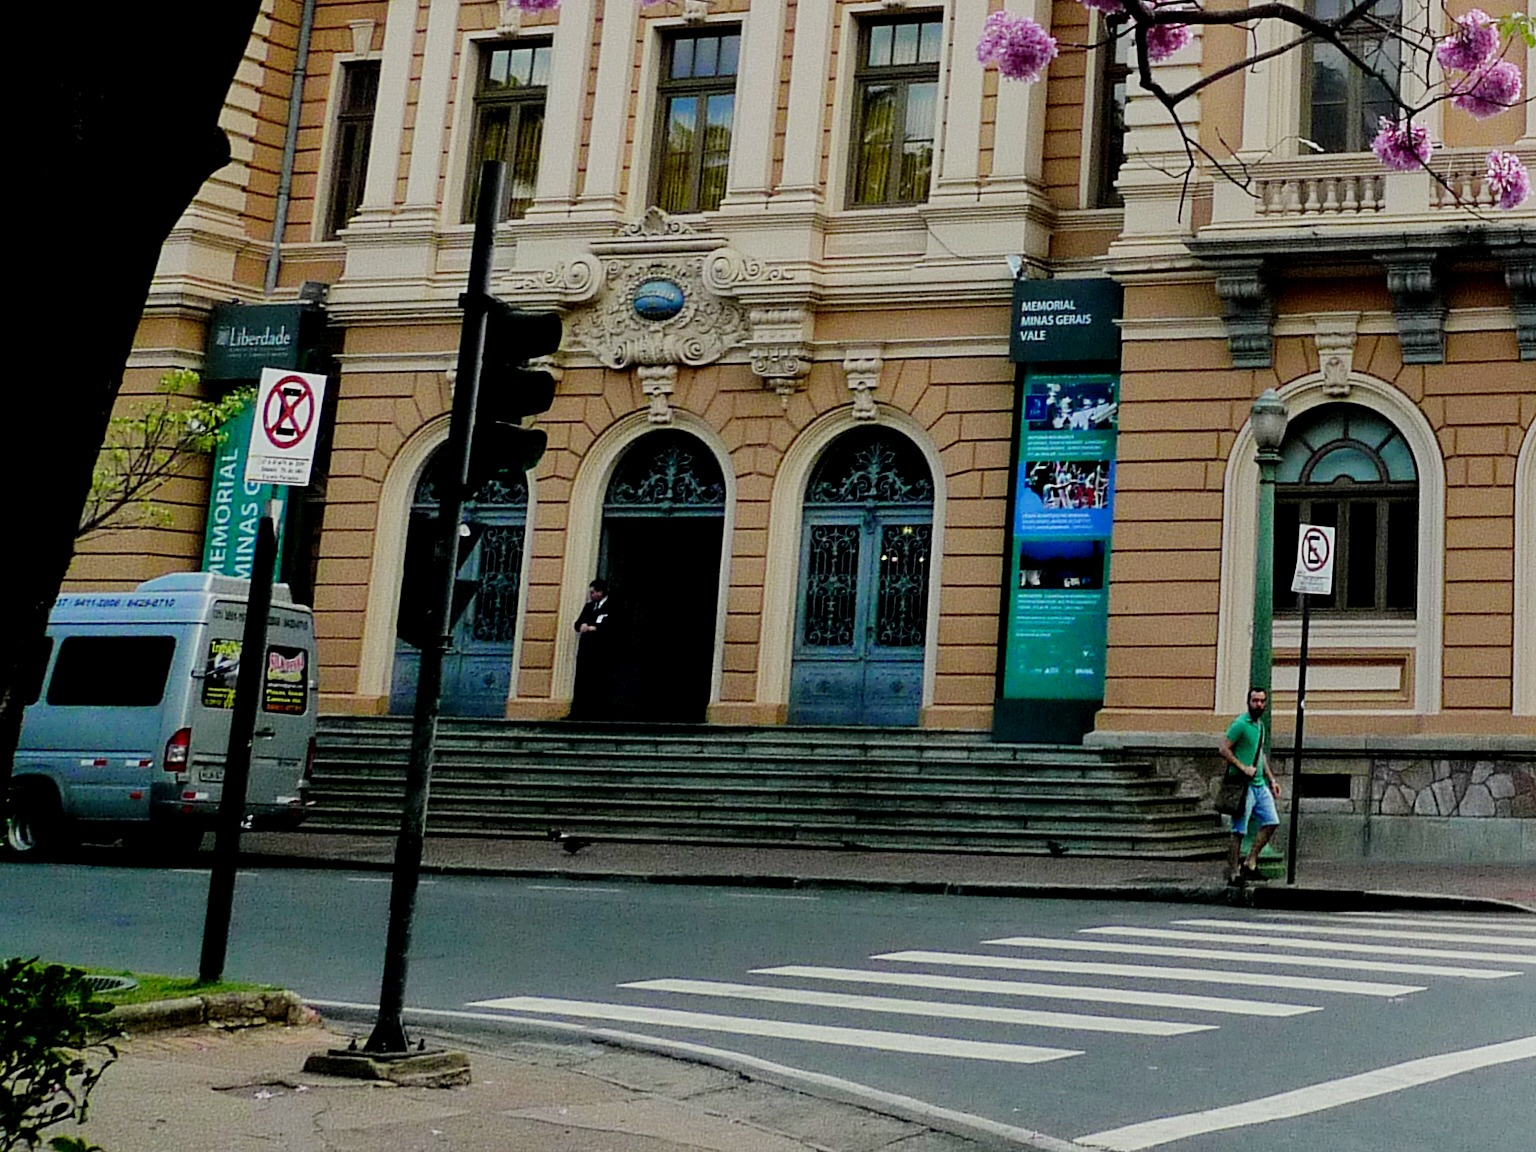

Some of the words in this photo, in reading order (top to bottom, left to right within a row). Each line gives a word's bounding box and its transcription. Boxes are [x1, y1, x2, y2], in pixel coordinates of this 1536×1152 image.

[1021, 300, 1076, 312] MEMORIAL
[1020, 315, 1054, 326] MINAS
[1056, 314, 1092, 325] GERAIS
[229, 325, 291, 346] Liberdade
[1020, 330, 1047, 341] VALE
